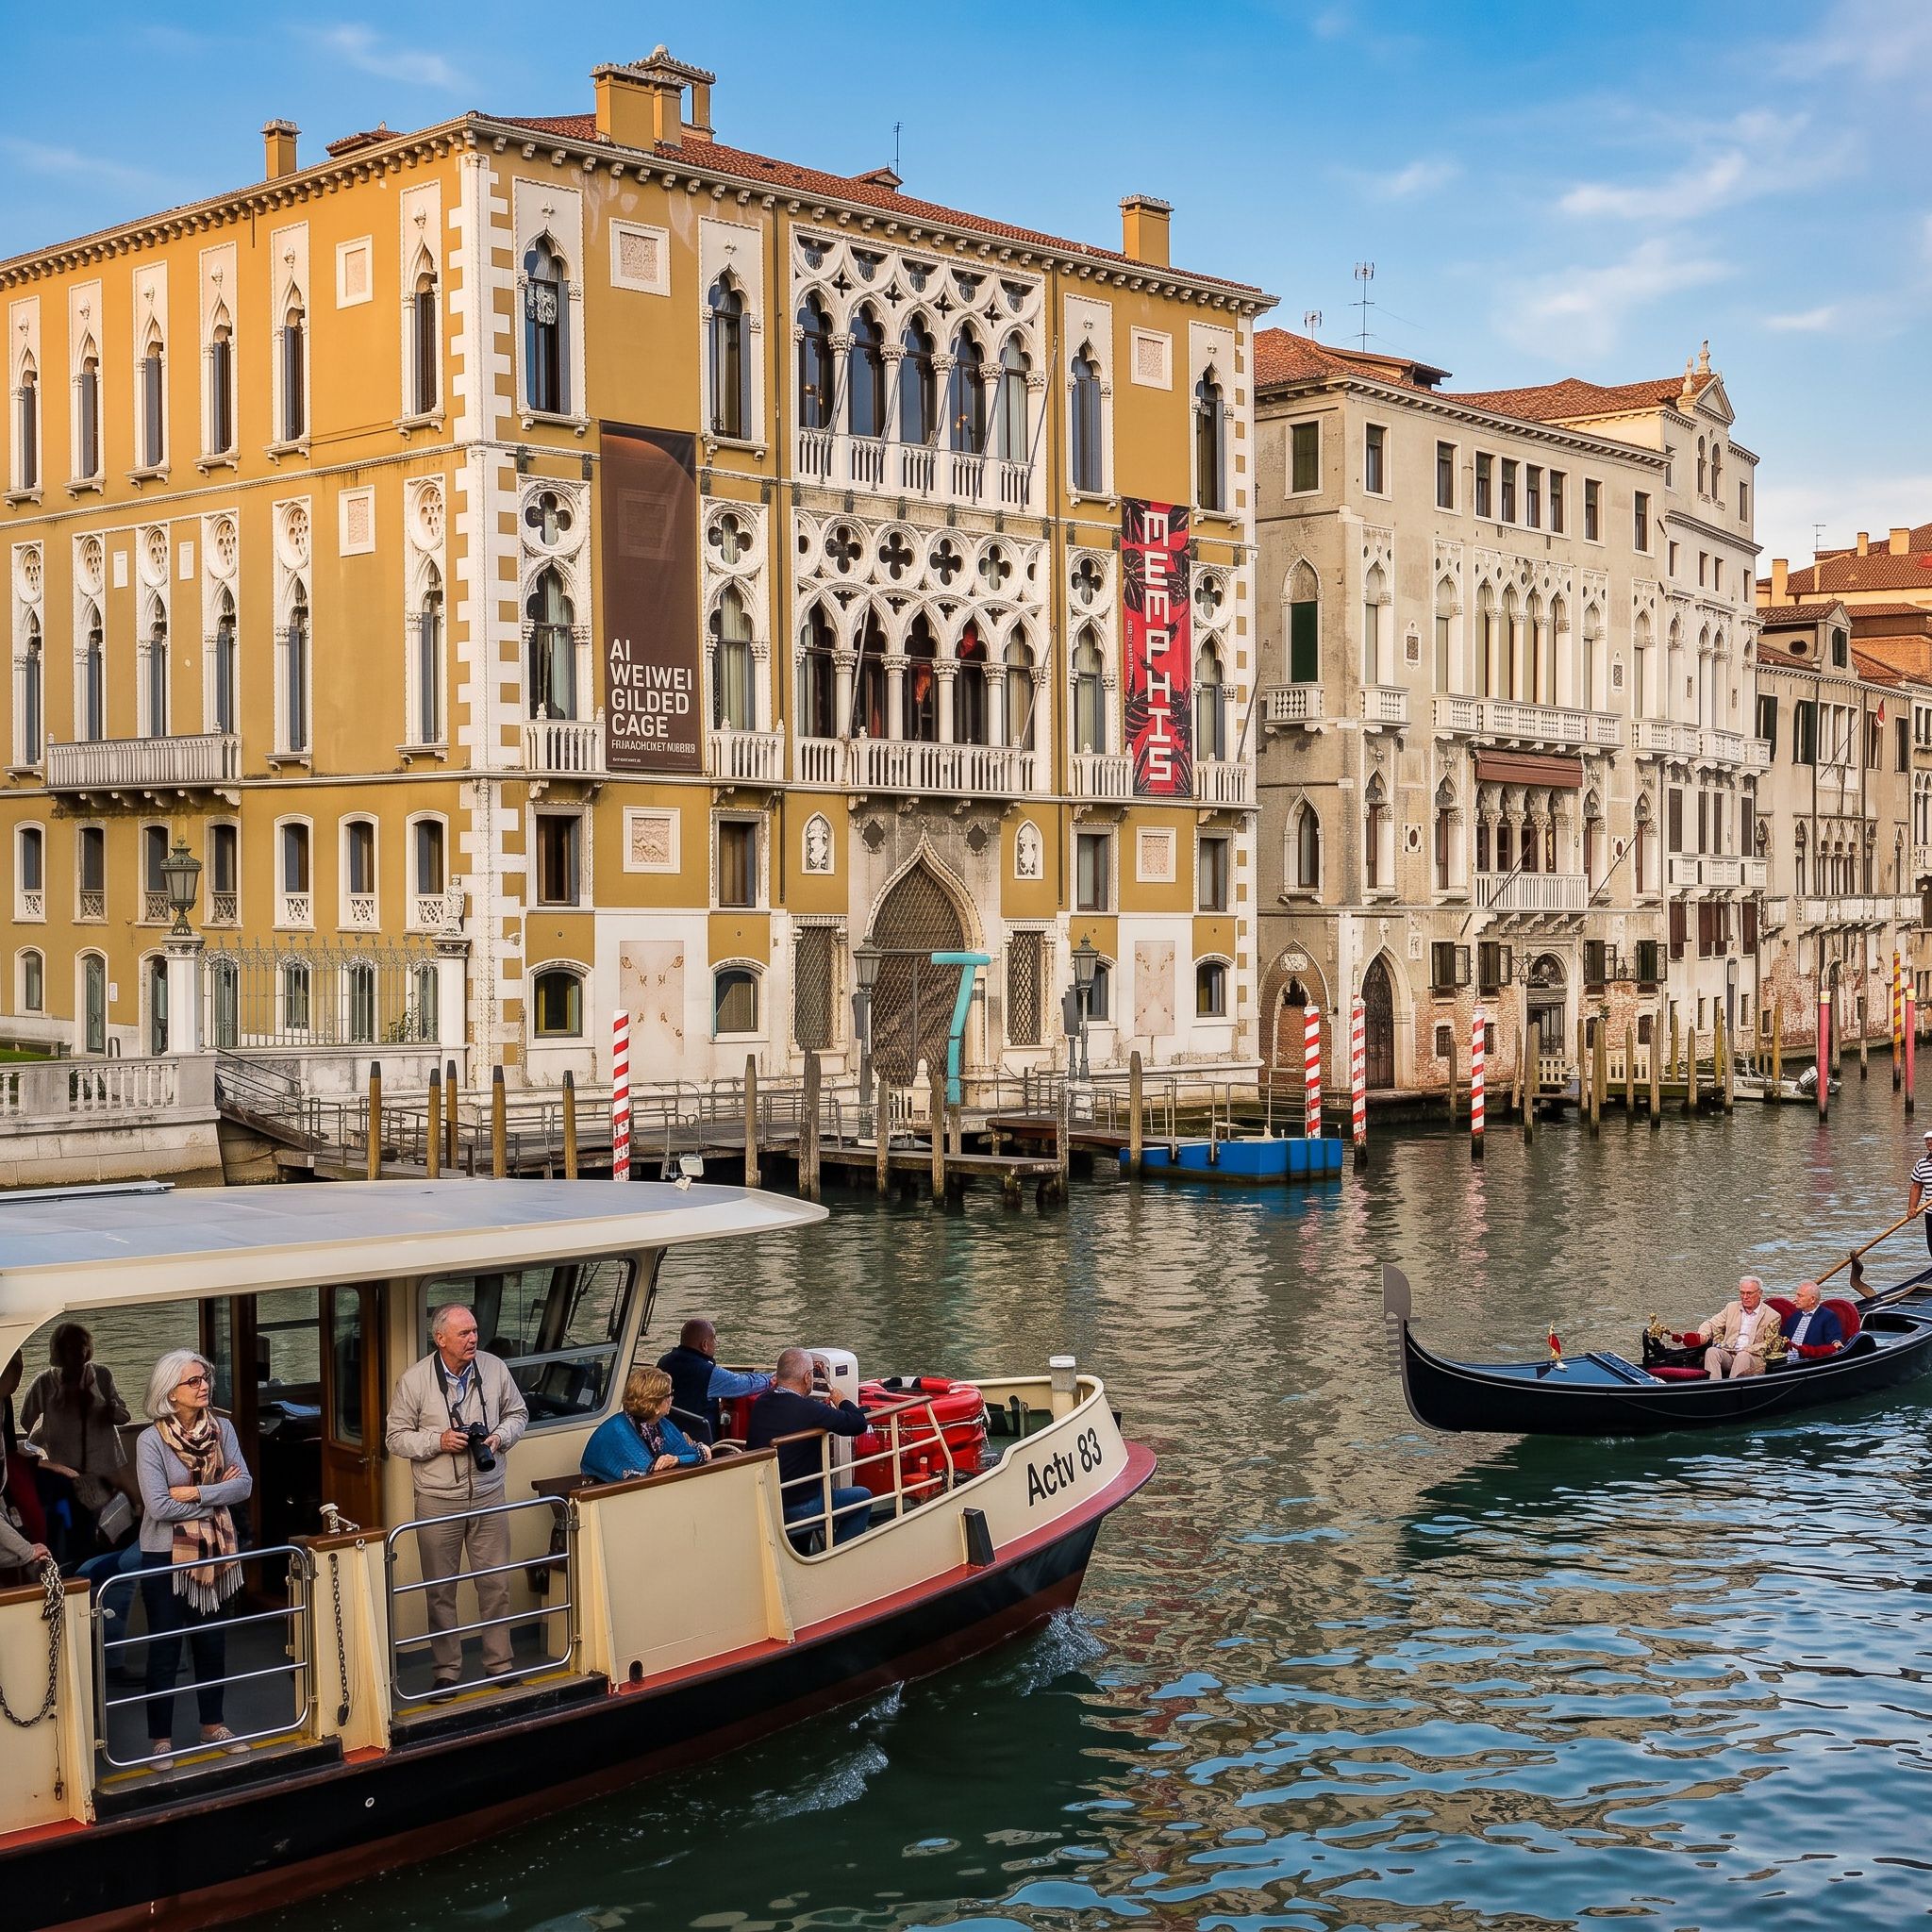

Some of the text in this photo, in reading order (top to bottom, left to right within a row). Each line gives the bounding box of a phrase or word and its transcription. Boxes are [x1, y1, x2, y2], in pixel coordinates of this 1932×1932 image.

[609, 638, 631, 661] AI
[1144, 510, 1172, 781] MEMPHIS
[609, 662, 692, 691] WEIWEI
[611, 688, 690, 715] GILDED
[611, 713, 669, 739] CAGE
[1027, 1427, 1102, 1507] Actv 83
